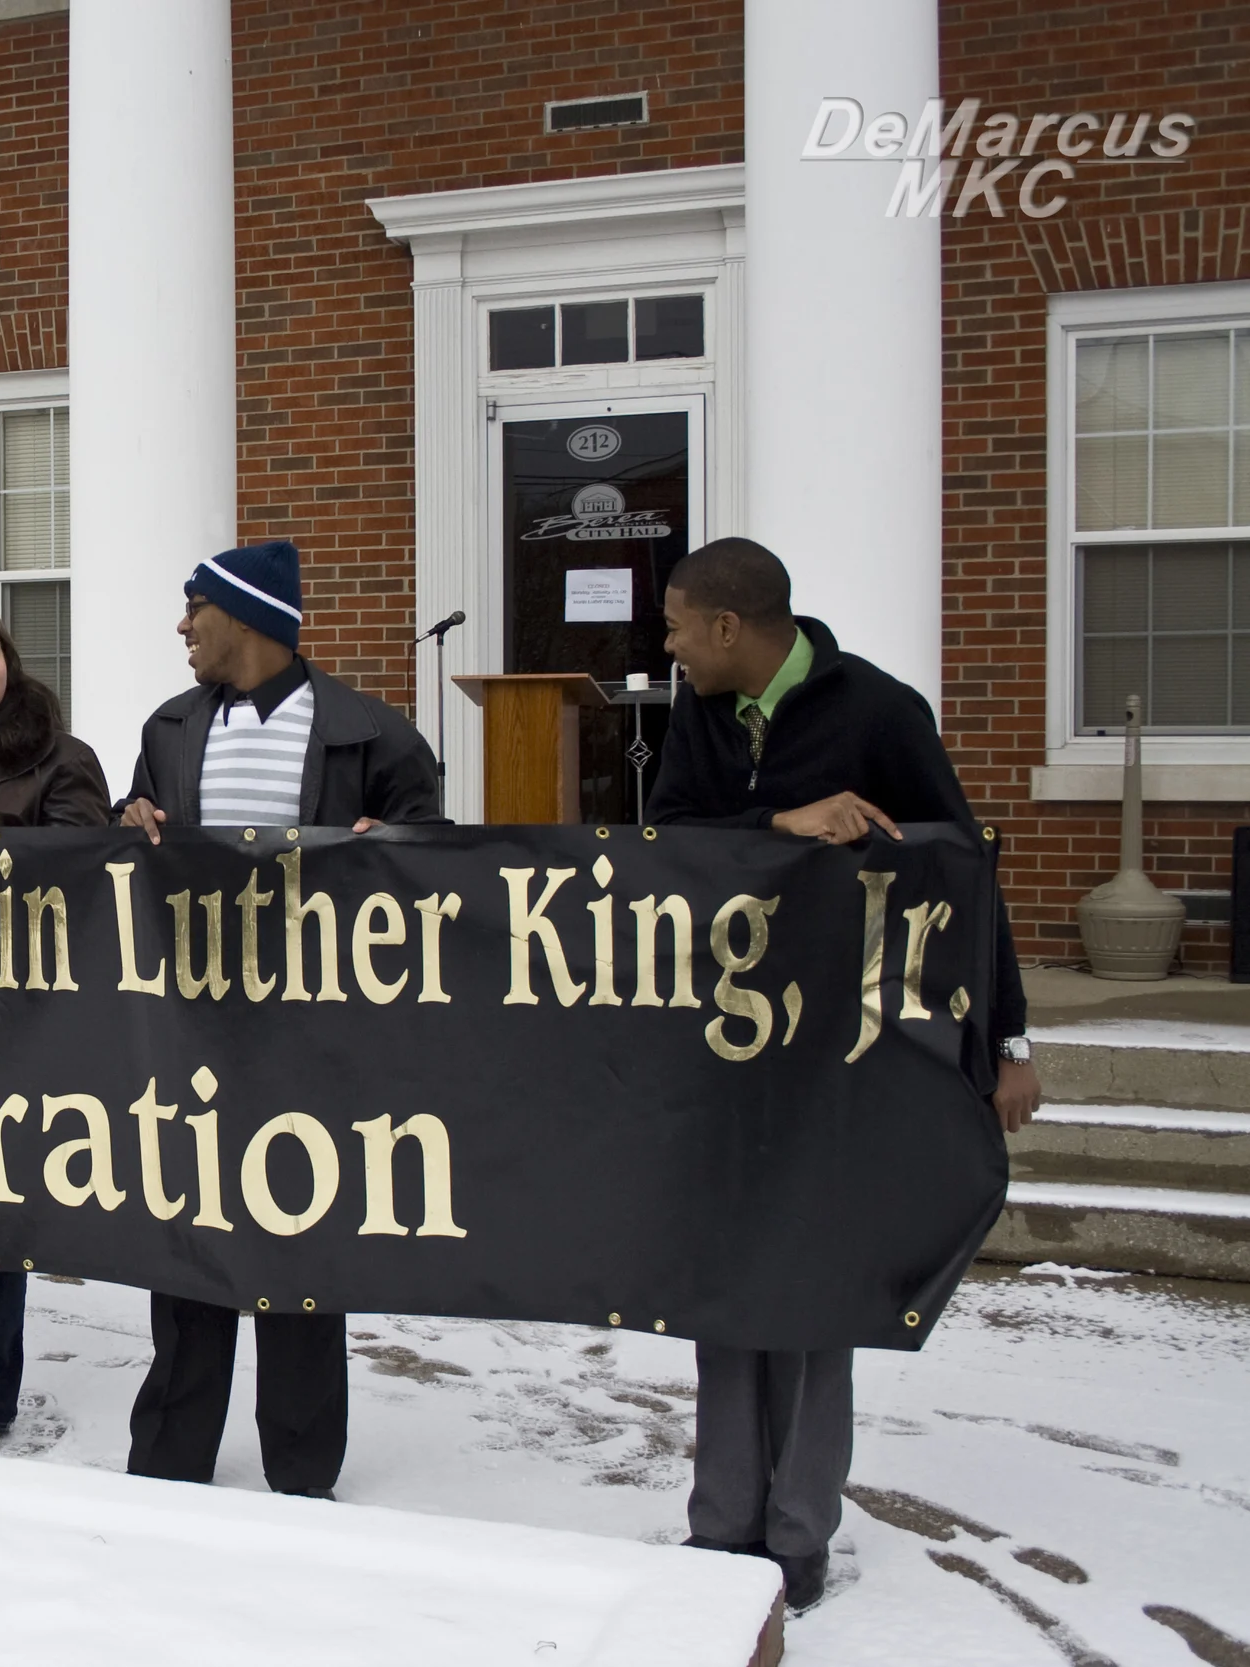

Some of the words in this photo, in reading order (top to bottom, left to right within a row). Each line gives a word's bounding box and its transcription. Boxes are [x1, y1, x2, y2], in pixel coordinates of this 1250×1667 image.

[578, 431, 610, 453] 212
[520, 509, 671, 541] Berea
[575, 528, 615, 539] CITY
[619, 527, 664, 537] HALL
[105, 846, 462, 1006] Luther
[499, 855, 803, 1062] King,
[844, 870, 972, 1065] Jr.
